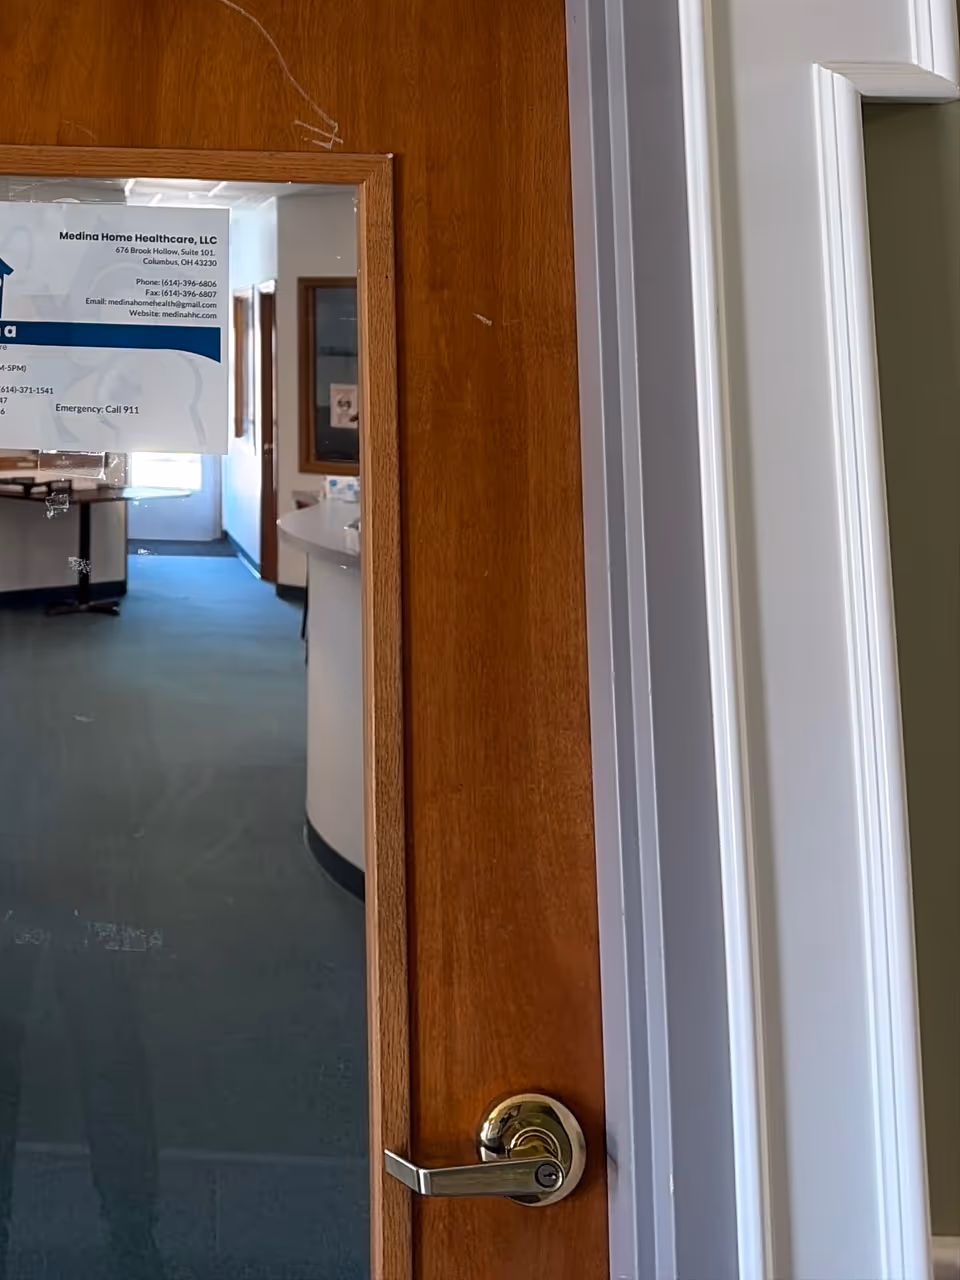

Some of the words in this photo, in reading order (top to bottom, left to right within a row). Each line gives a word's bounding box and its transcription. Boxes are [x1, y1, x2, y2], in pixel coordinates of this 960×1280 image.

[59, 231, 99, 242] Medina
[101, 233, 133, 242] Home
[135, 233, 197, 245] Healthcare,
[199, 235, 218, 245] LLC
[115, 246, 129, 254] 676
[130, 246, 152, 255] Brook
[153, 247, 180, 256] Hollow,
[181, 248, 200, 256] Suite
[142, 257, 180, 266] Columbus,
[180, 258, 193, 267] OH
[194, 259, 218, 267] 43230
[136, 278, 160, 286] Phone:
[161, 279, 217, 288] (614)-396-6806
[145, 289, 160, 297] Fax:
[161, 289, 217, 298] (614)-396-6807
[107, 298, 217, 309] medinahomehealth@gmail.com
[129, 309, 161, 317] Website:
[162, 310, 217, 319] medinahhc.com
[55, 403, 104, 414] Emergency:
[105, 405, 122, 414] Call
[123, 405, 140, 415] 911
